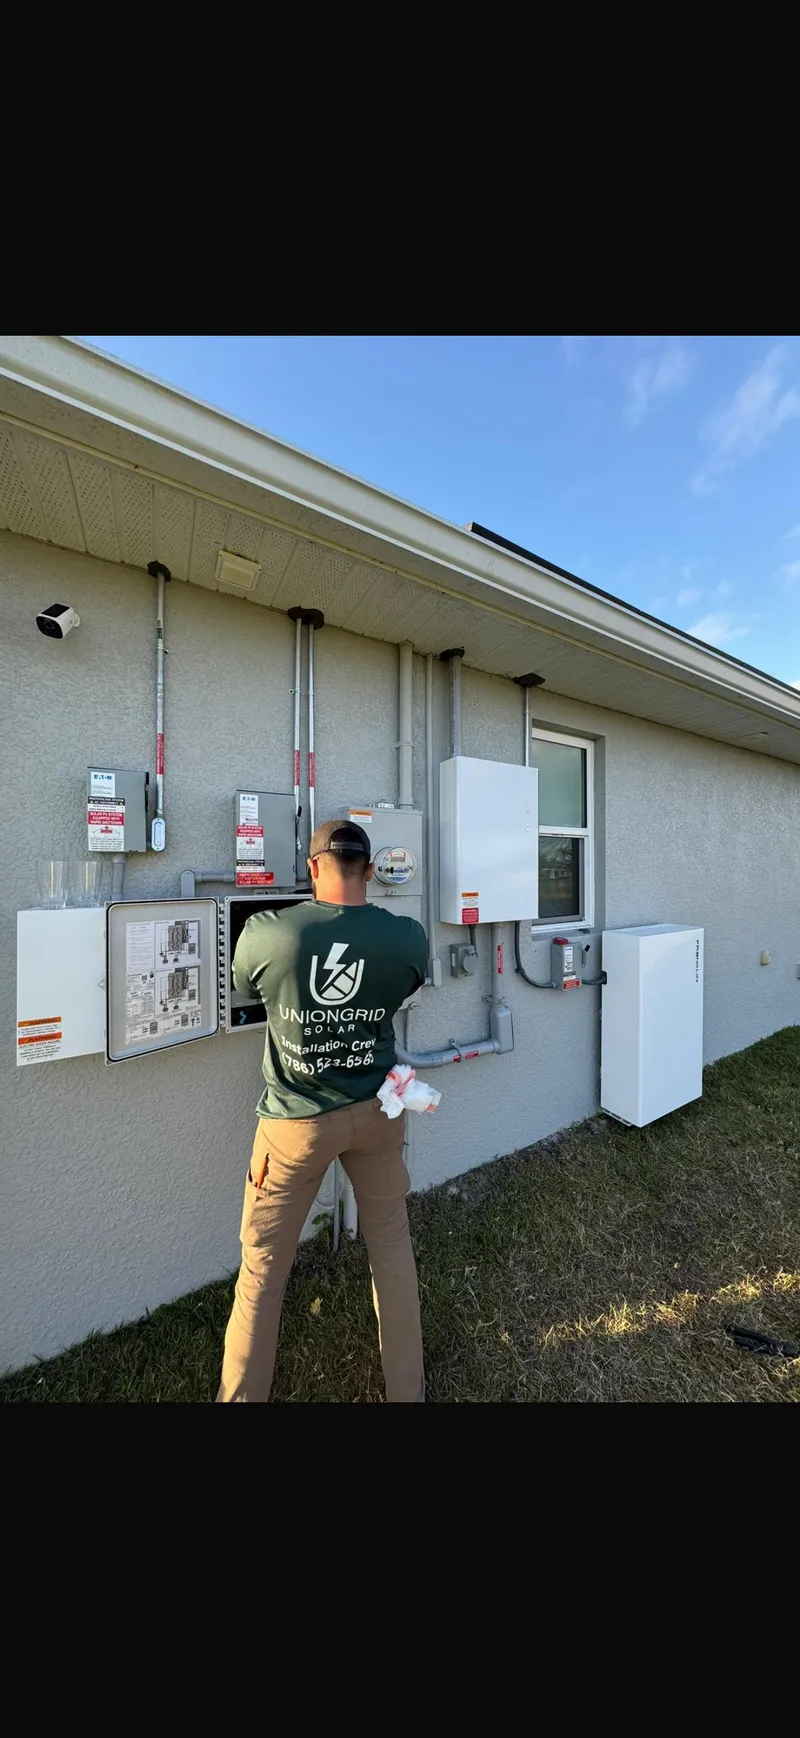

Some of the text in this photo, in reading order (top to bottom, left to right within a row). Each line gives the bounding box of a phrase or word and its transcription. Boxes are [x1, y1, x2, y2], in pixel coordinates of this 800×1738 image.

[28, 1017, 58, 1025] WARNING
[279, 1004, 386, 1024] UNIONGRID
[28, 1033, 57, 1042] WARNING
[304, 1024, 355, 1036] SOLAR
[281, 1035, 348, 1056] Installation
[282, 1052, 315, 1075] (786)
